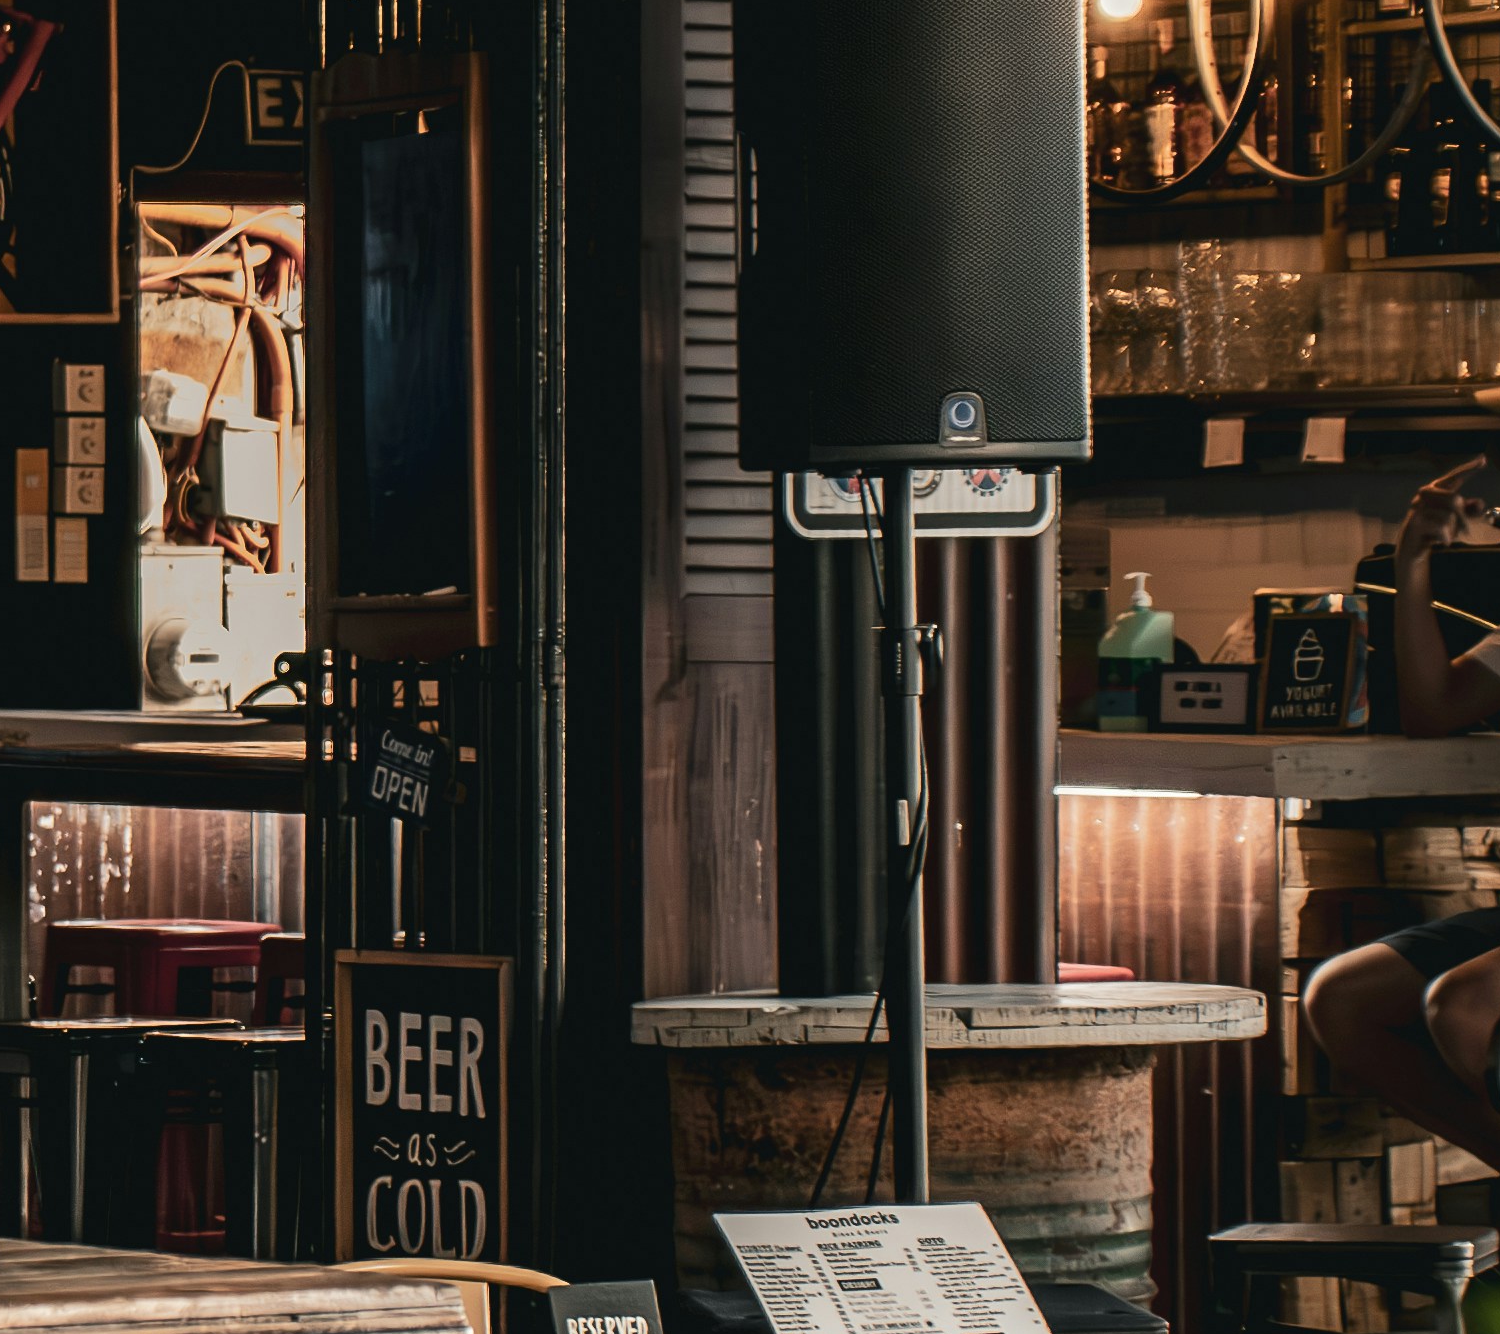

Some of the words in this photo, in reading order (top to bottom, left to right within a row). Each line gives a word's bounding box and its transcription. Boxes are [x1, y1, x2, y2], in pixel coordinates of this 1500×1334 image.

[381, 729, 414, 759] Come
[371, 766, 429, 817] OPEN
[366, 1009, 486, 1118] BEER
[408, 1133, 437, 1167] as
[367, 1175, 487, 1260] COLD
[806, 1212, 899, 1230] boondocks
